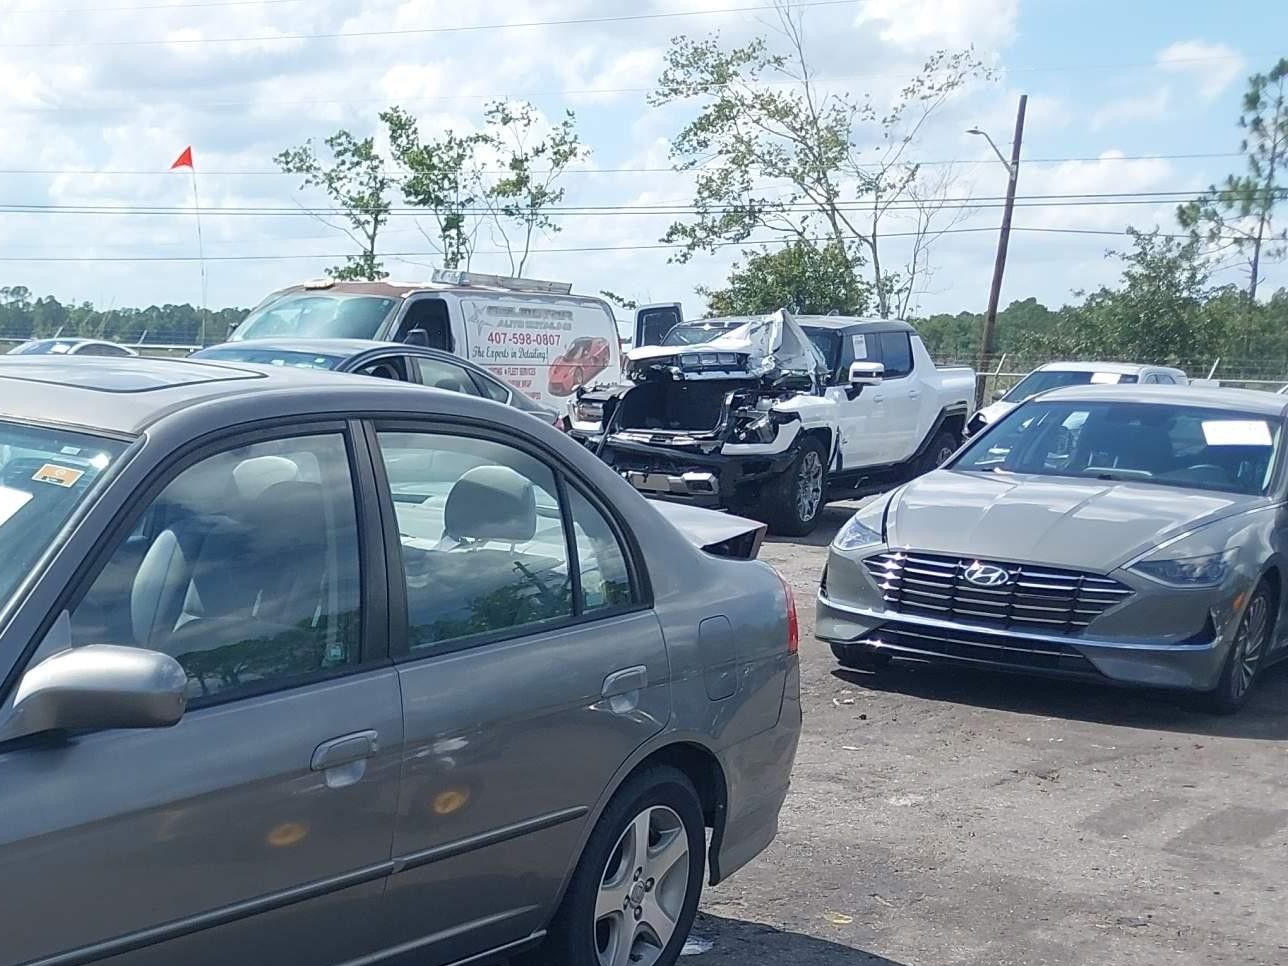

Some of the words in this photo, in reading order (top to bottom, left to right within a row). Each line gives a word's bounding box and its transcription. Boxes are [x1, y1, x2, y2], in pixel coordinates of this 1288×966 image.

[487, 332, 561, 346] 407-598-0807
[472, 345, 485, 358] The
[486, 346, 510, 362] Experts
[510, 347, 517, 358] in
